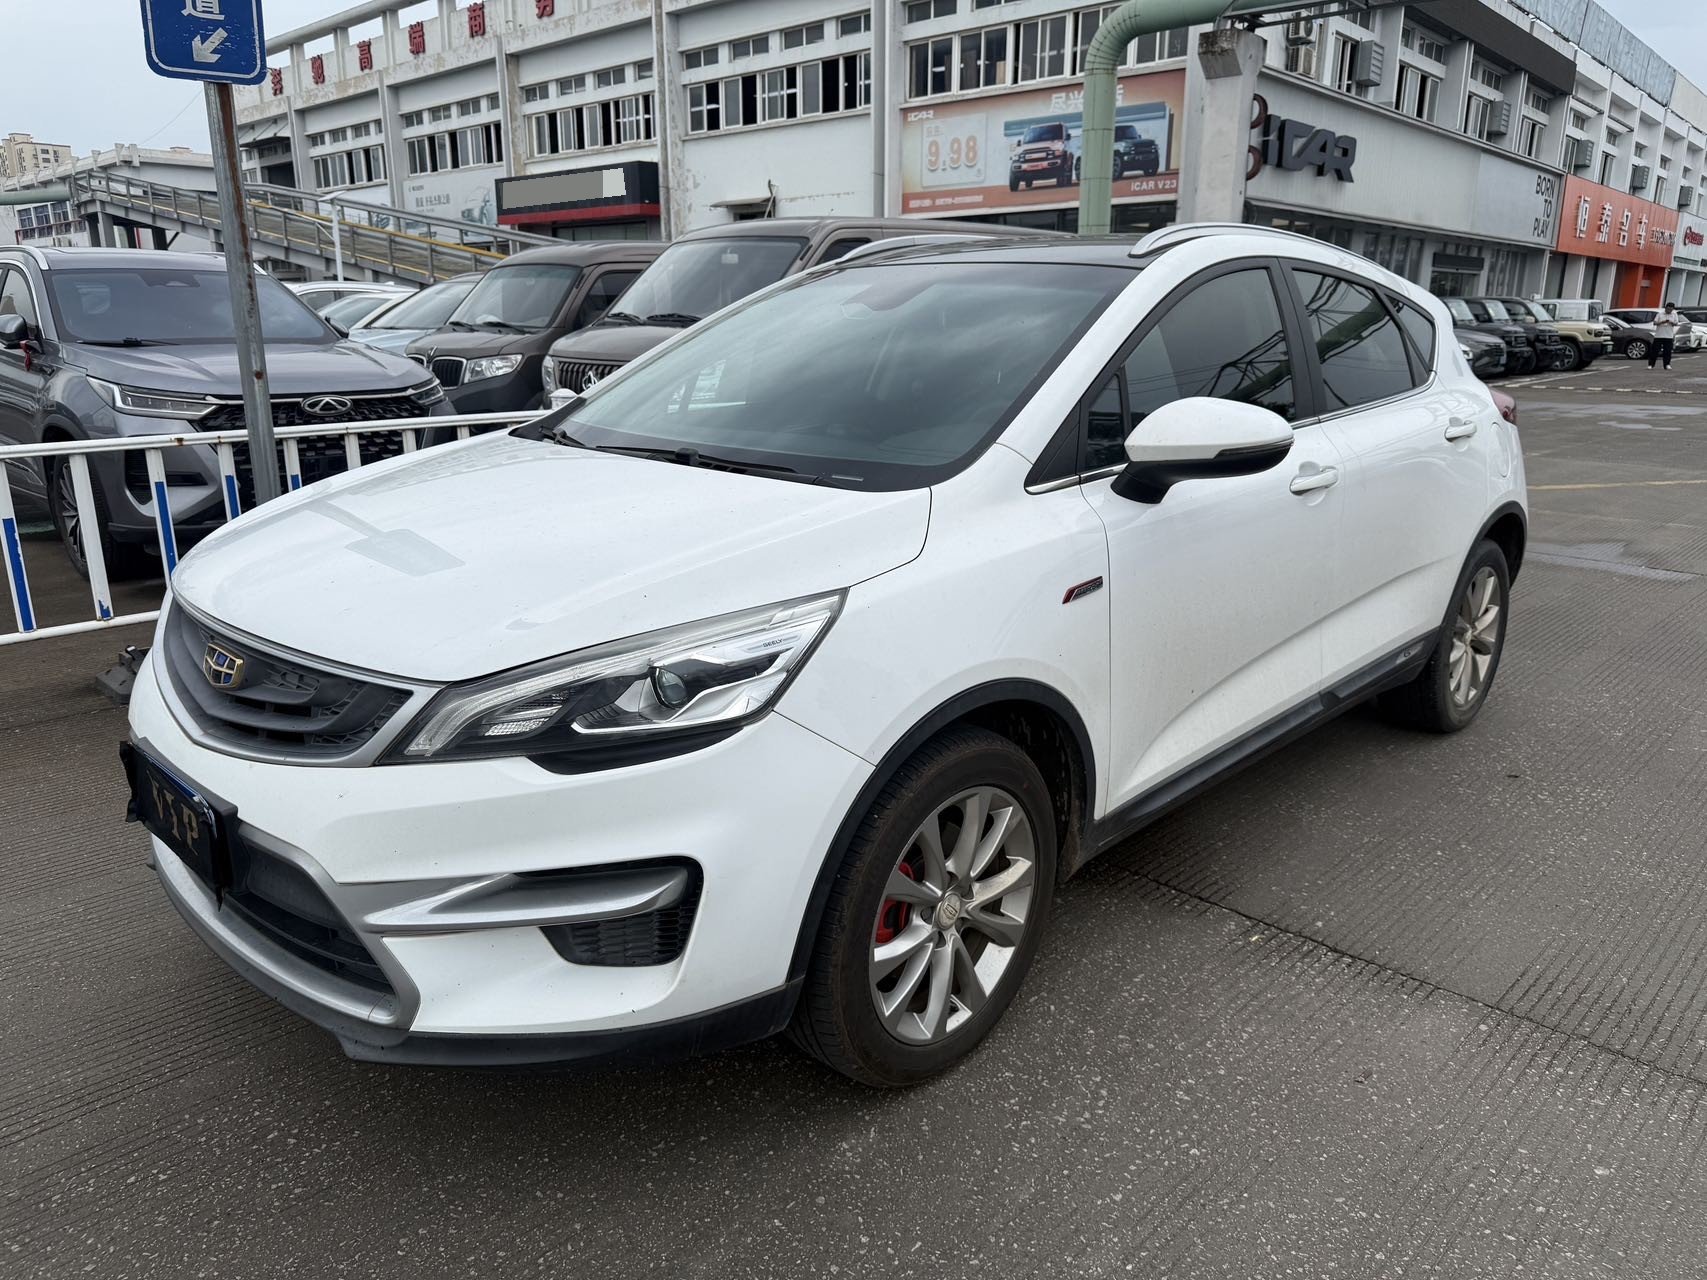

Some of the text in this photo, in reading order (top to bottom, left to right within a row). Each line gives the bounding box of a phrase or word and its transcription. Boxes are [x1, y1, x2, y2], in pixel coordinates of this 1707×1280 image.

[927, 135, 977, 171] 9.98
[1158, 180, 1177, 189] V23
[1535, 174, 1556, 200] BORN
[1542, 198, 1553, 218] TO
[1533, 217, 1550, 238] PLAY
